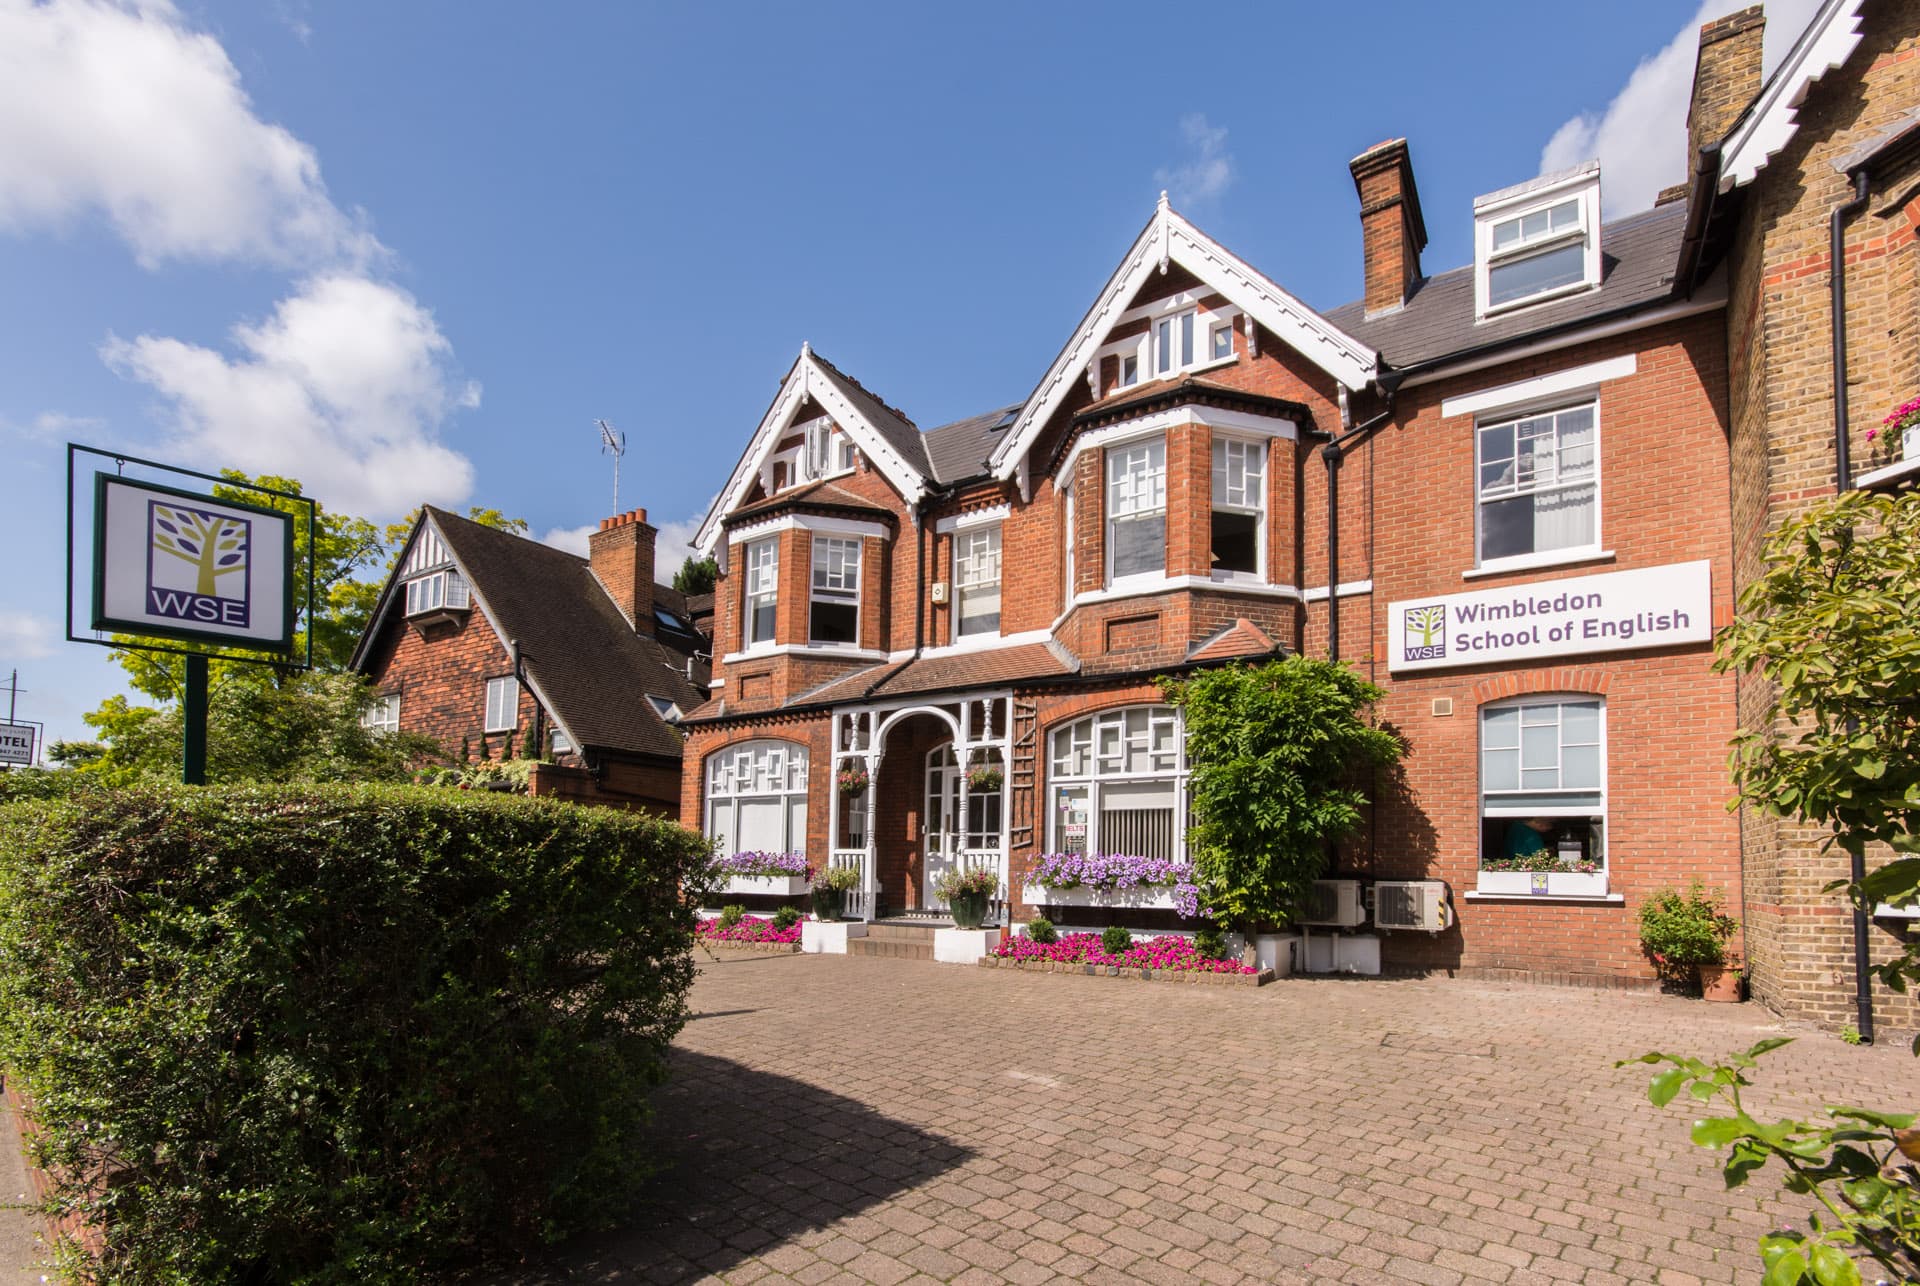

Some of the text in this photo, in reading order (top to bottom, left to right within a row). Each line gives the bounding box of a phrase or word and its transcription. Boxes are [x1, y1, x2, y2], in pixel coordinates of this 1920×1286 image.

[151, 590, 246, 625] WSE
[1455, 592, 1602, 625] Wimbledon
[1455, 609, 1690, 652] School of English
[1406, 646, 1445, 660] WSE
[0, 736, 28, 748] TEL
